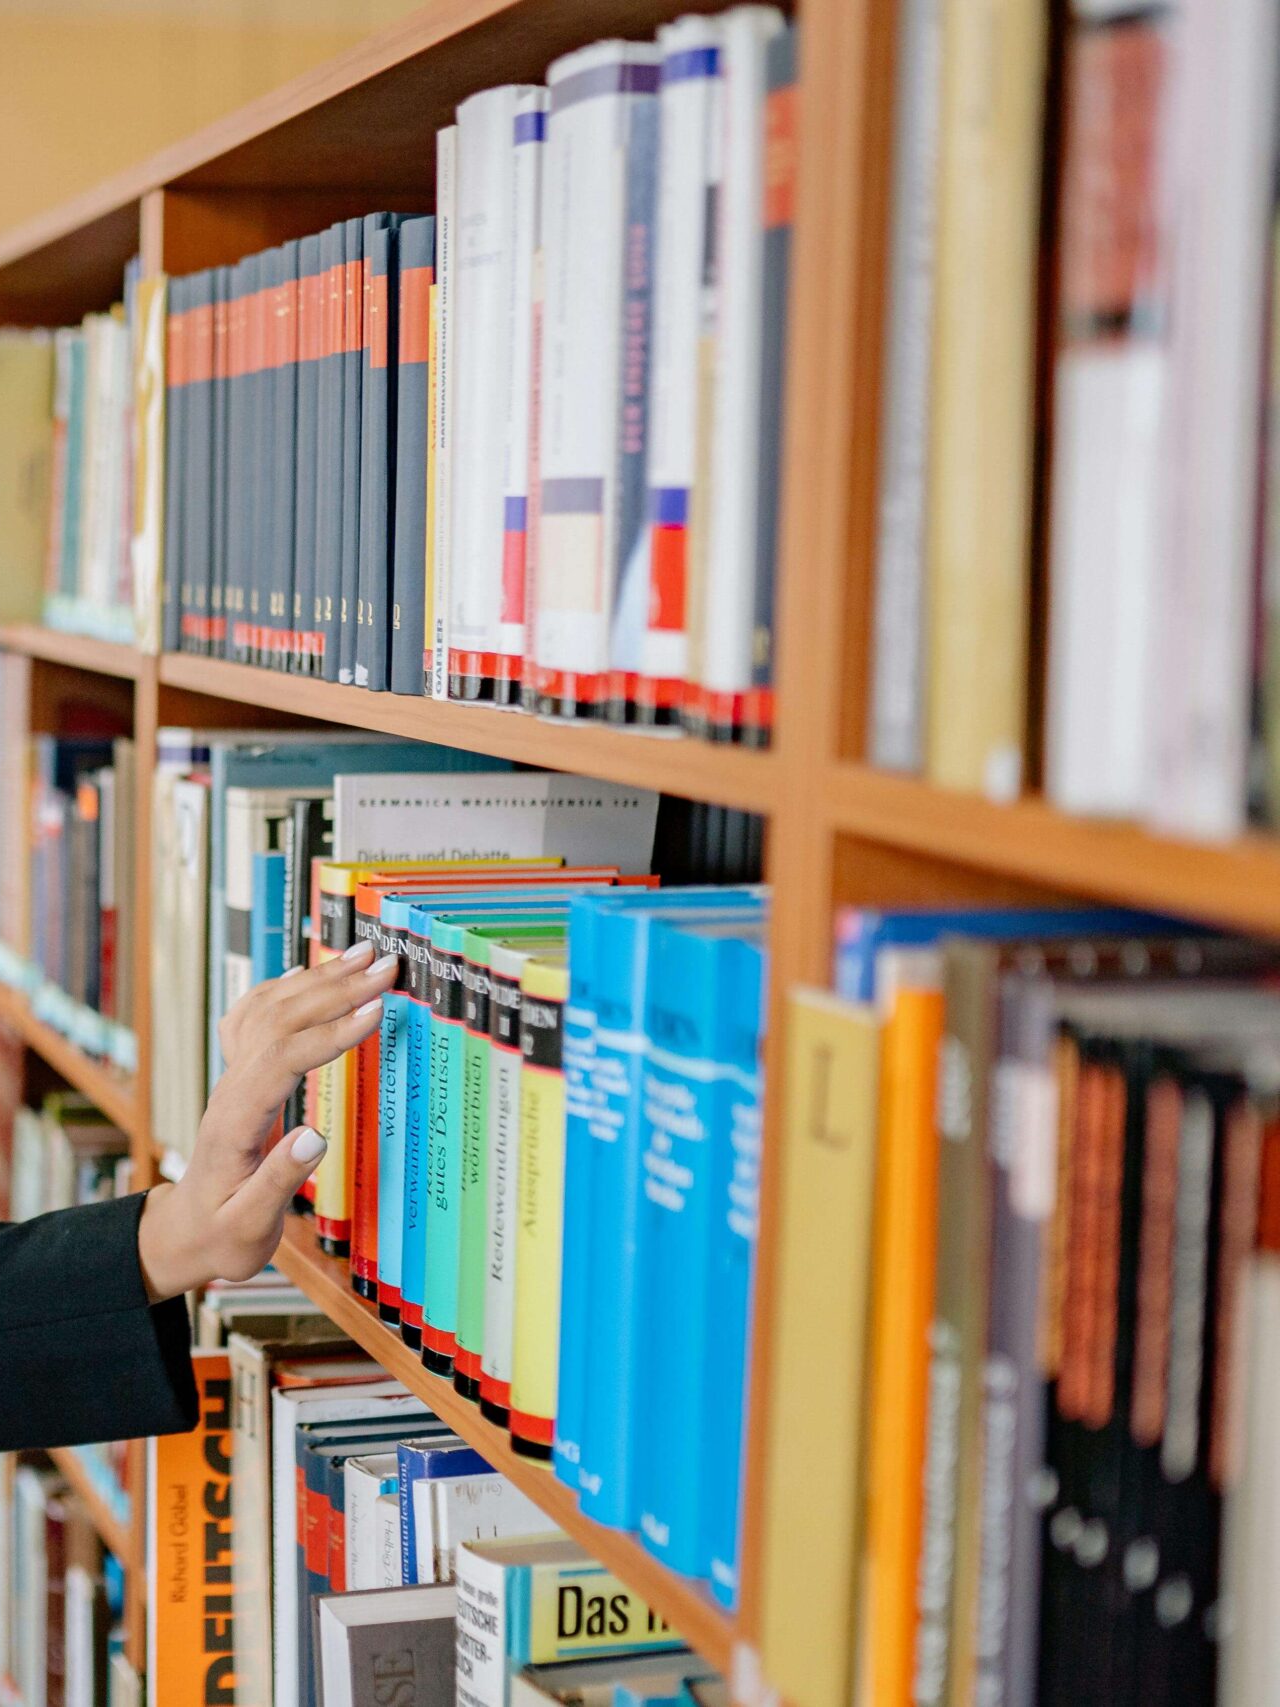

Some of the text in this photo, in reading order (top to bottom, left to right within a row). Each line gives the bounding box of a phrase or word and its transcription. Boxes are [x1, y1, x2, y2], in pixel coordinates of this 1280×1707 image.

[357, 847, 511, 863] Diskurs und Debatte
[358, 799, 451, 808] GERMANICA
[461, 799, 603, 808] WRATISLAVIENSIA
[411, 971, 417, 988] 8
[435, 988, 441, 1005] 9
[384, 1007, 398, 1138] wörterbuch
[408, 1023, 423, 1230] verwandte Wörter
[436, 1035, 449, 1211] gutes Deutsch
[470, 1054, 482, 1185] wörterbuch
[491, 1067, 510, 1282] Redewendungen
[169, 1484, 188, 1604] Richard Göbel
[557, 1585, 630, 1639] Das
